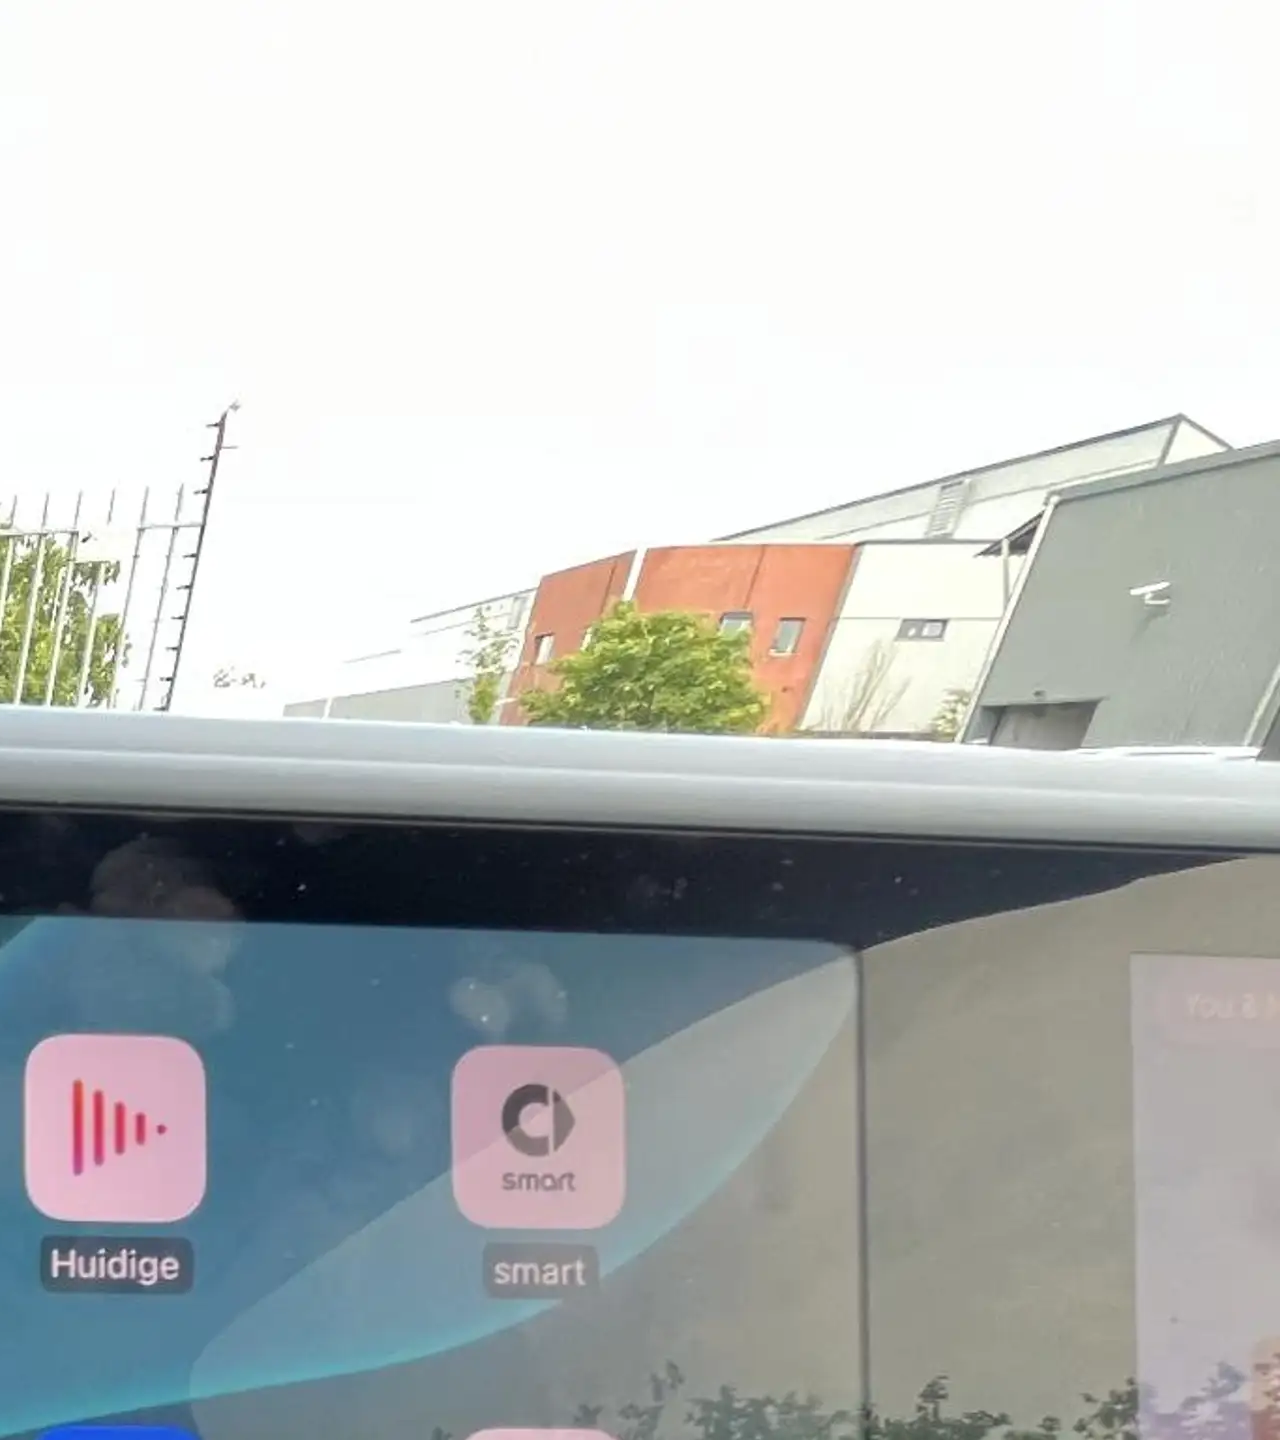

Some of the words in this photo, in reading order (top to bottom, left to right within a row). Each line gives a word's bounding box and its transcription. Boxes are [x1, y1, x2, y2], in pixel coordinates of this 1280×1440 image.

[501, 1170, 577, 1193] smart
[51, 1248, 180, 1286] Huidige
[494, 1259, 586, 1287] smart
